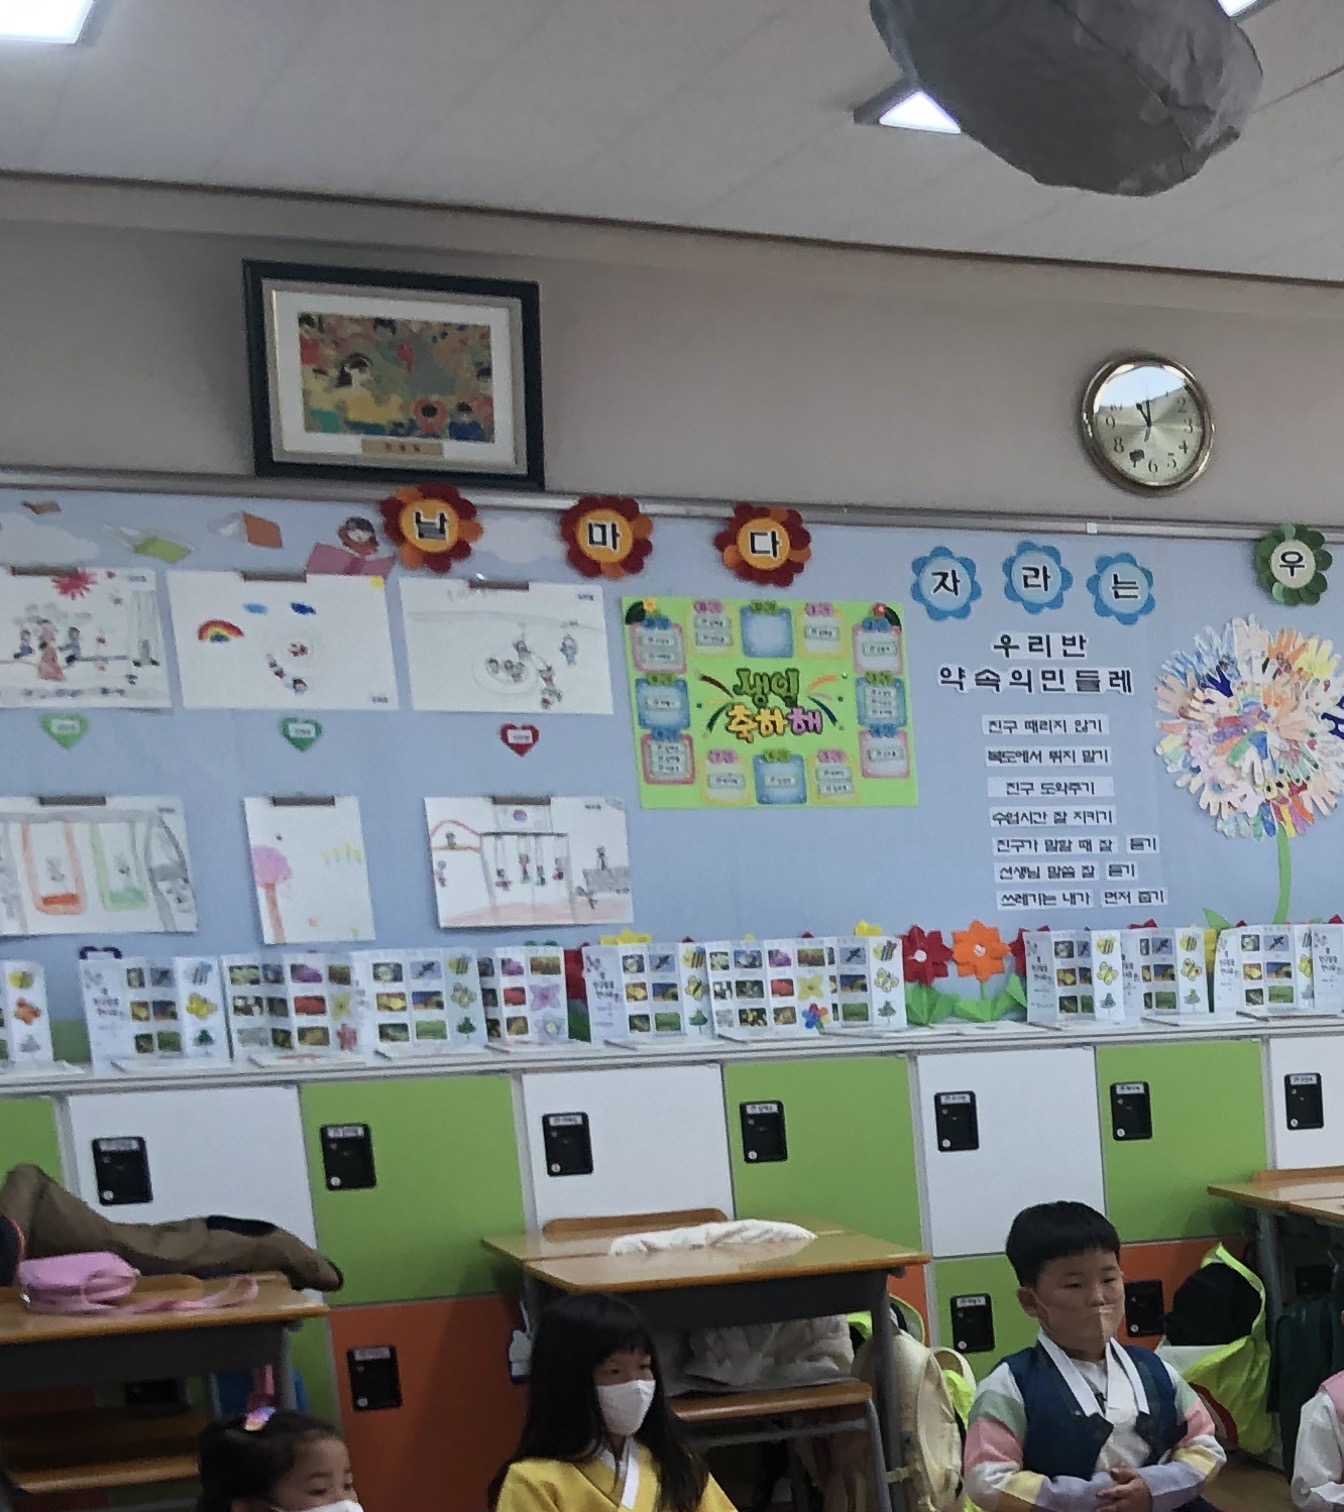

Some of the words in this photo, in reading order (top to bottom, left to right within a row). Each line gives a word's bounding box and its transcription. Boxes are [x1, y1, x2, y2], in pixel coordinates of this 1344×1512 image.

[588, 522, 621, 551] 마
[750, 529, 781, 558] 다
[1279, 550, 1306, 577] 우
[931, 569, 961, 596] 자
[1022, 565, 1051, 592] 라
[1111, 573, 1140, 600] 는
[732, 667, 801, 708] 생일
[725, 702, 823, 745] 축하해
[988, 719, 1018, 734] 친구
[1024, 719, 1067, 734] 때리지
[1075, 719, 1103, 733] 않기
[987, 749, 1043, 765] 복도에서
[1082, 749, 1109, 764] 말기
[1005, 781, 1035, 796] 친구
[1040, 781, 1096, 796] 도와주기
[992, 810, 1048, 826] 수업시간
[1053, 810, 1068, 825] 잘
[1073, 810, 1113, 825] 지키기
[996, 838, 1039, 854] 친구가
[1044, 838, 1073, 853] 말할
[1078, 838, 1093, 853] 때
[1098, 838, 1113, 853] 잘
[999, 865, 1041, 881] 선생님
[1047, 865, 1076, 880] 말씀
[1081, 865, 1096, 880] 잘
[1001, 892, 1058, 907] 쓰레기는
[1062, 891, 1091, 905] 내가
[1104, 890, 1132, 905] 먼저
